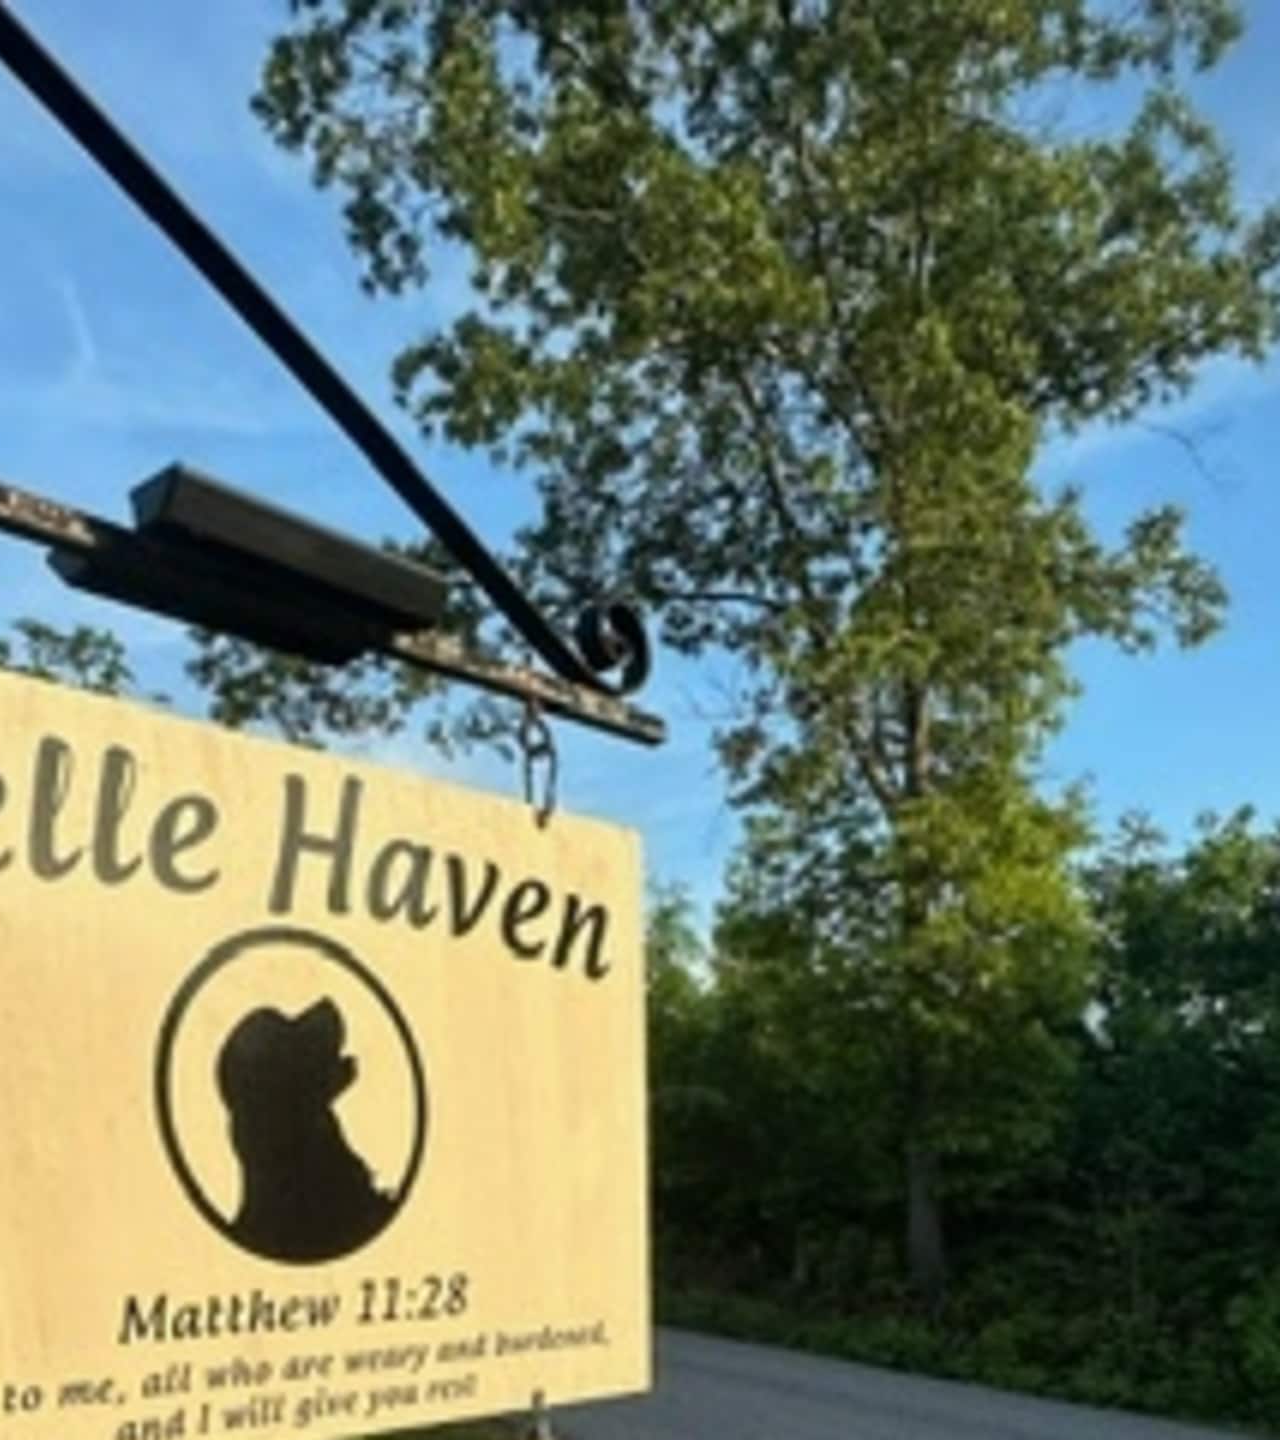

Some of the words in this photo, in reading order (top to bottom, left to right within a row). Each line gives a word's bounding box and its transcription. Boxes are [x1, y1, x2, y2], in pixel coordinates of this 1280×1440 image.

[266, 770, 613, 979] Haven
[117, 1286, 342, 1346] Matthew
[357, 1272, 469, 1325] 11:28
[2, 1383, 44, 1413] to
[57, 1378, 126, 1408] me,
[141, 1363, 193, 1400] all
[206, 1356, 273, 1390] who
[281, 1353, 335, 1381] are
[344, 1343, 430, 1374] weary
[436, 1332, 488, 1362] and
[197, 1403, 212, 1436] I
[223, 1393, 286, 1431] will
[292, 1387, 360, 1428] give
[365, 1384, 420, 1416] you
